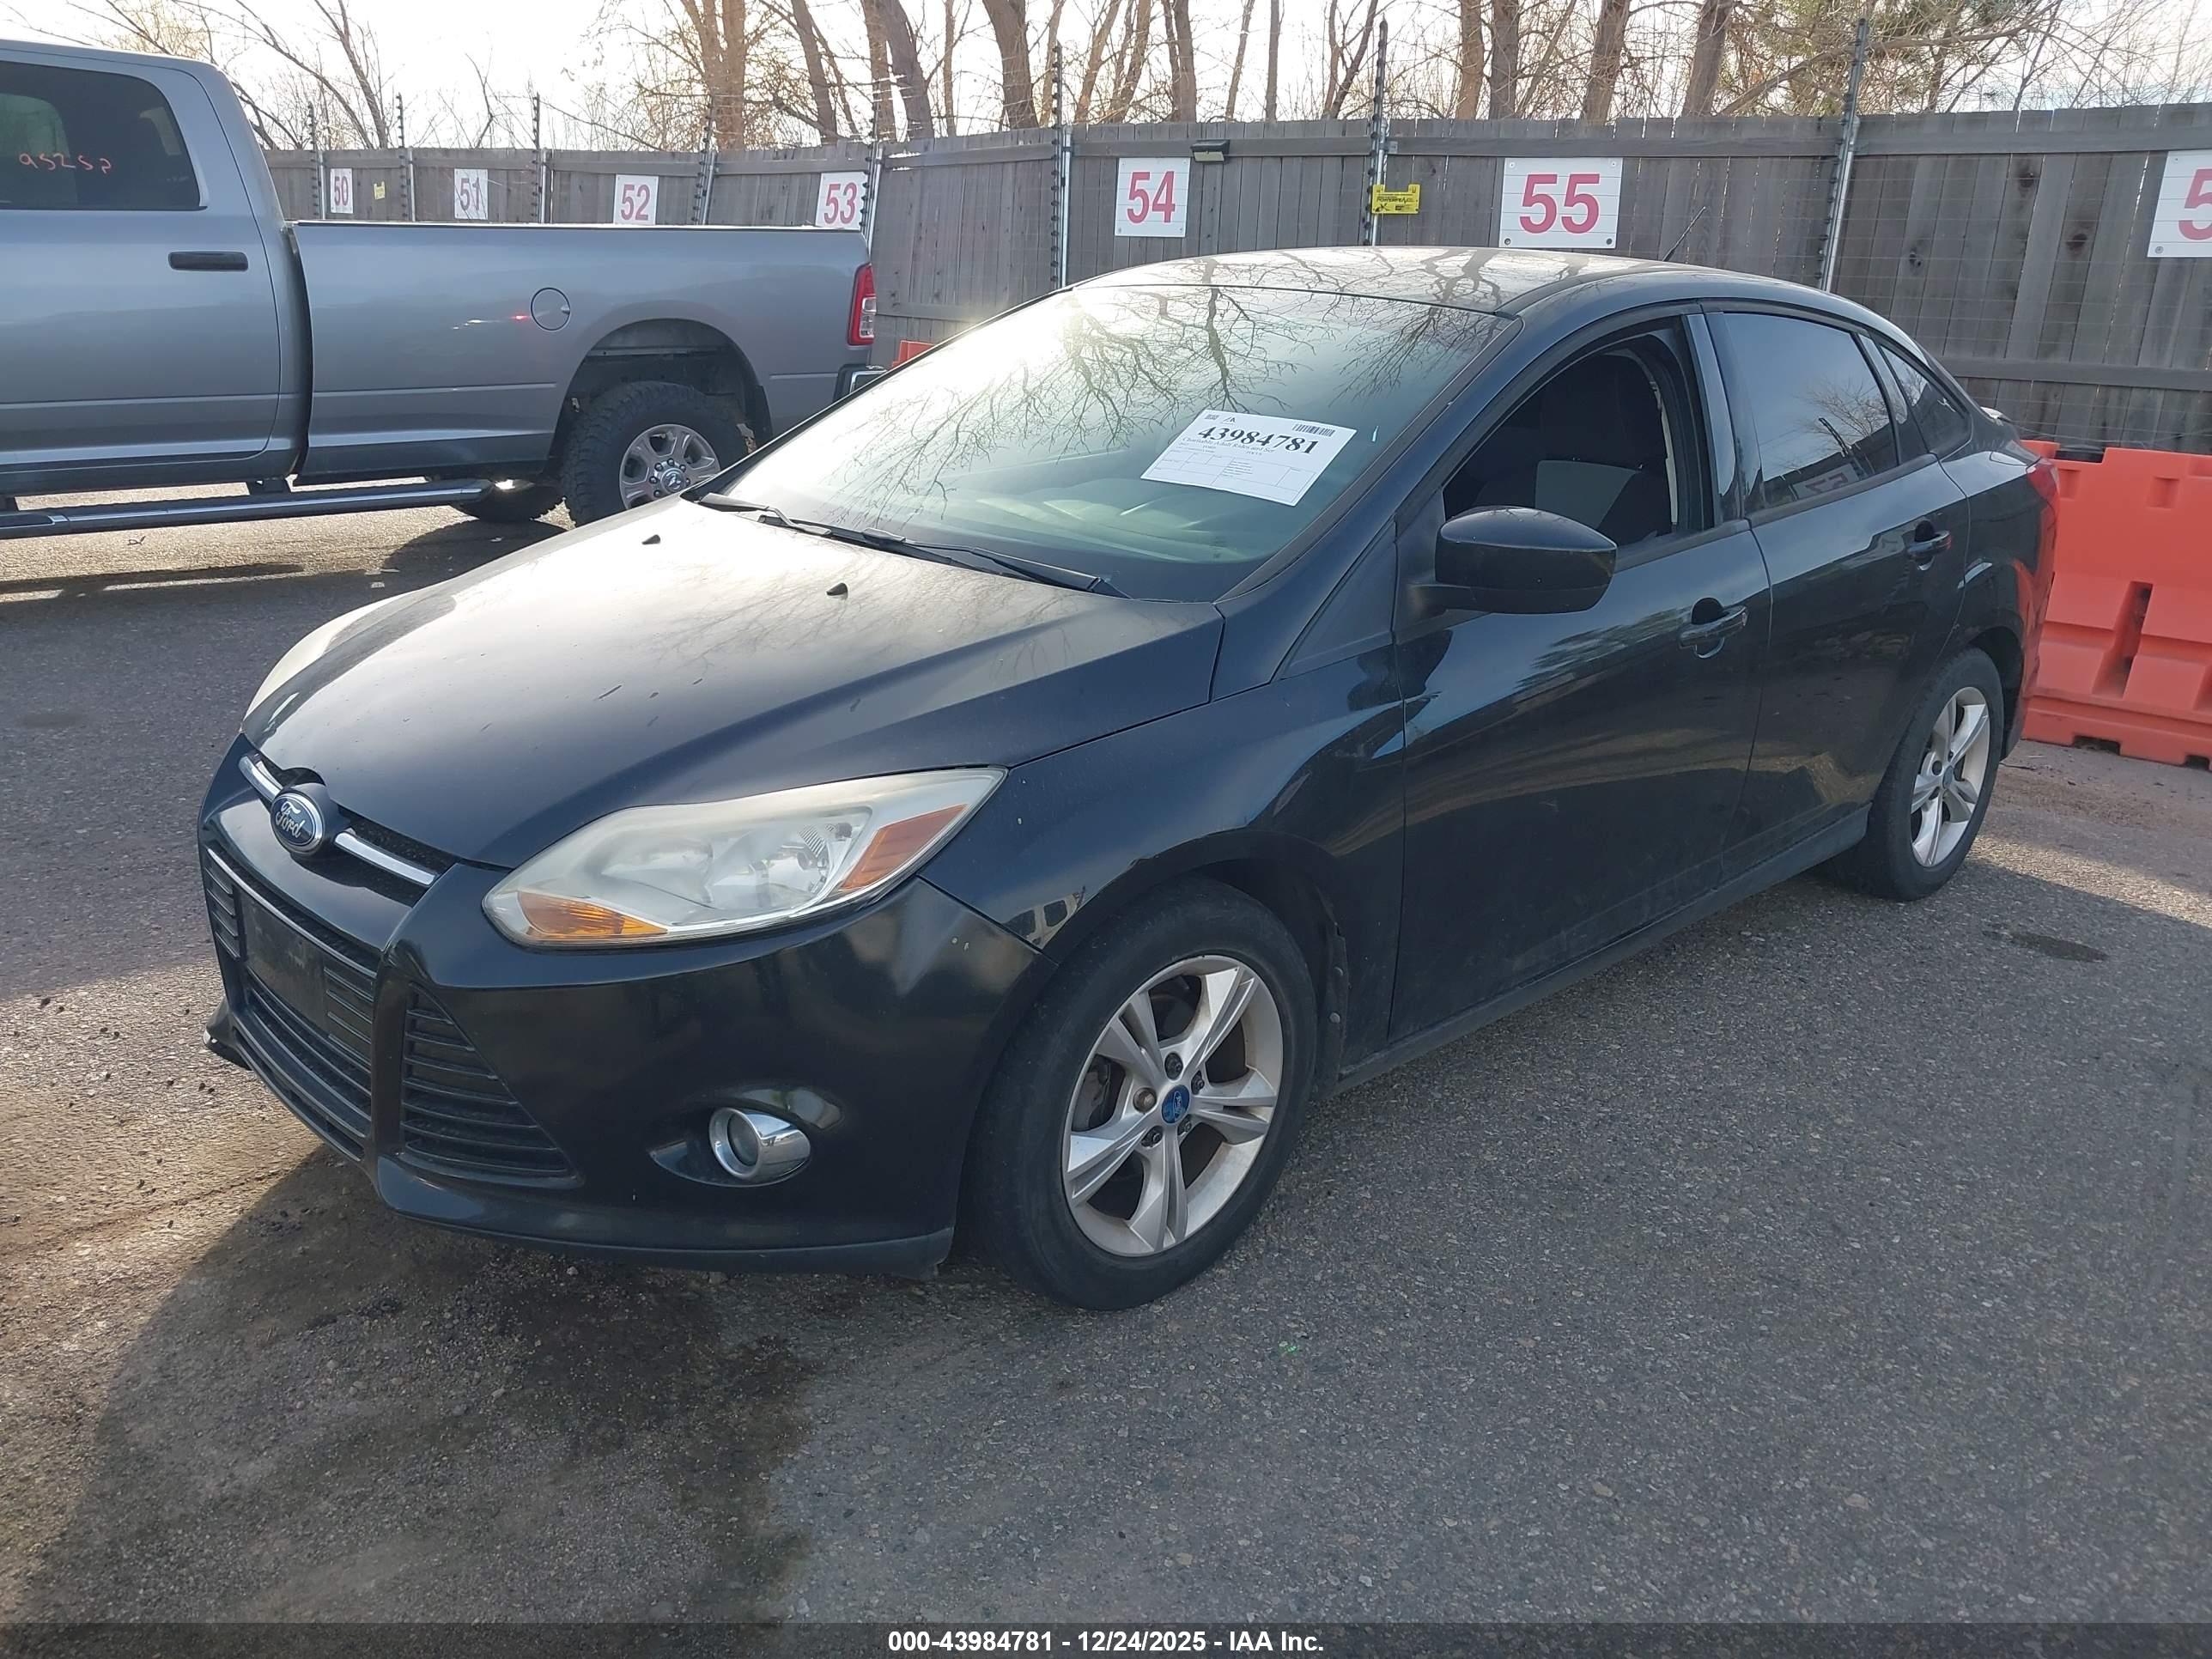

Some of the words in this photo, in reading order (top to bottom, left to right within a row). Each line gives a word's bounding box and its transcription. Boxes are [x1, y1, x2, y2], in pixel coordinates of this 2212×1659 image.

[333, 176, 349, 206] 50
[459, 177, 482, 211] 51
[620, 184, 649, 221] 52
[824, 182, 858, 224] 53
[1127, 170, 1176, 224] 54
[1519, 172, 1601, 234] 55
[1197, 426, 1320, 455] 43984781
[275, 800, 306, 839] Ford
